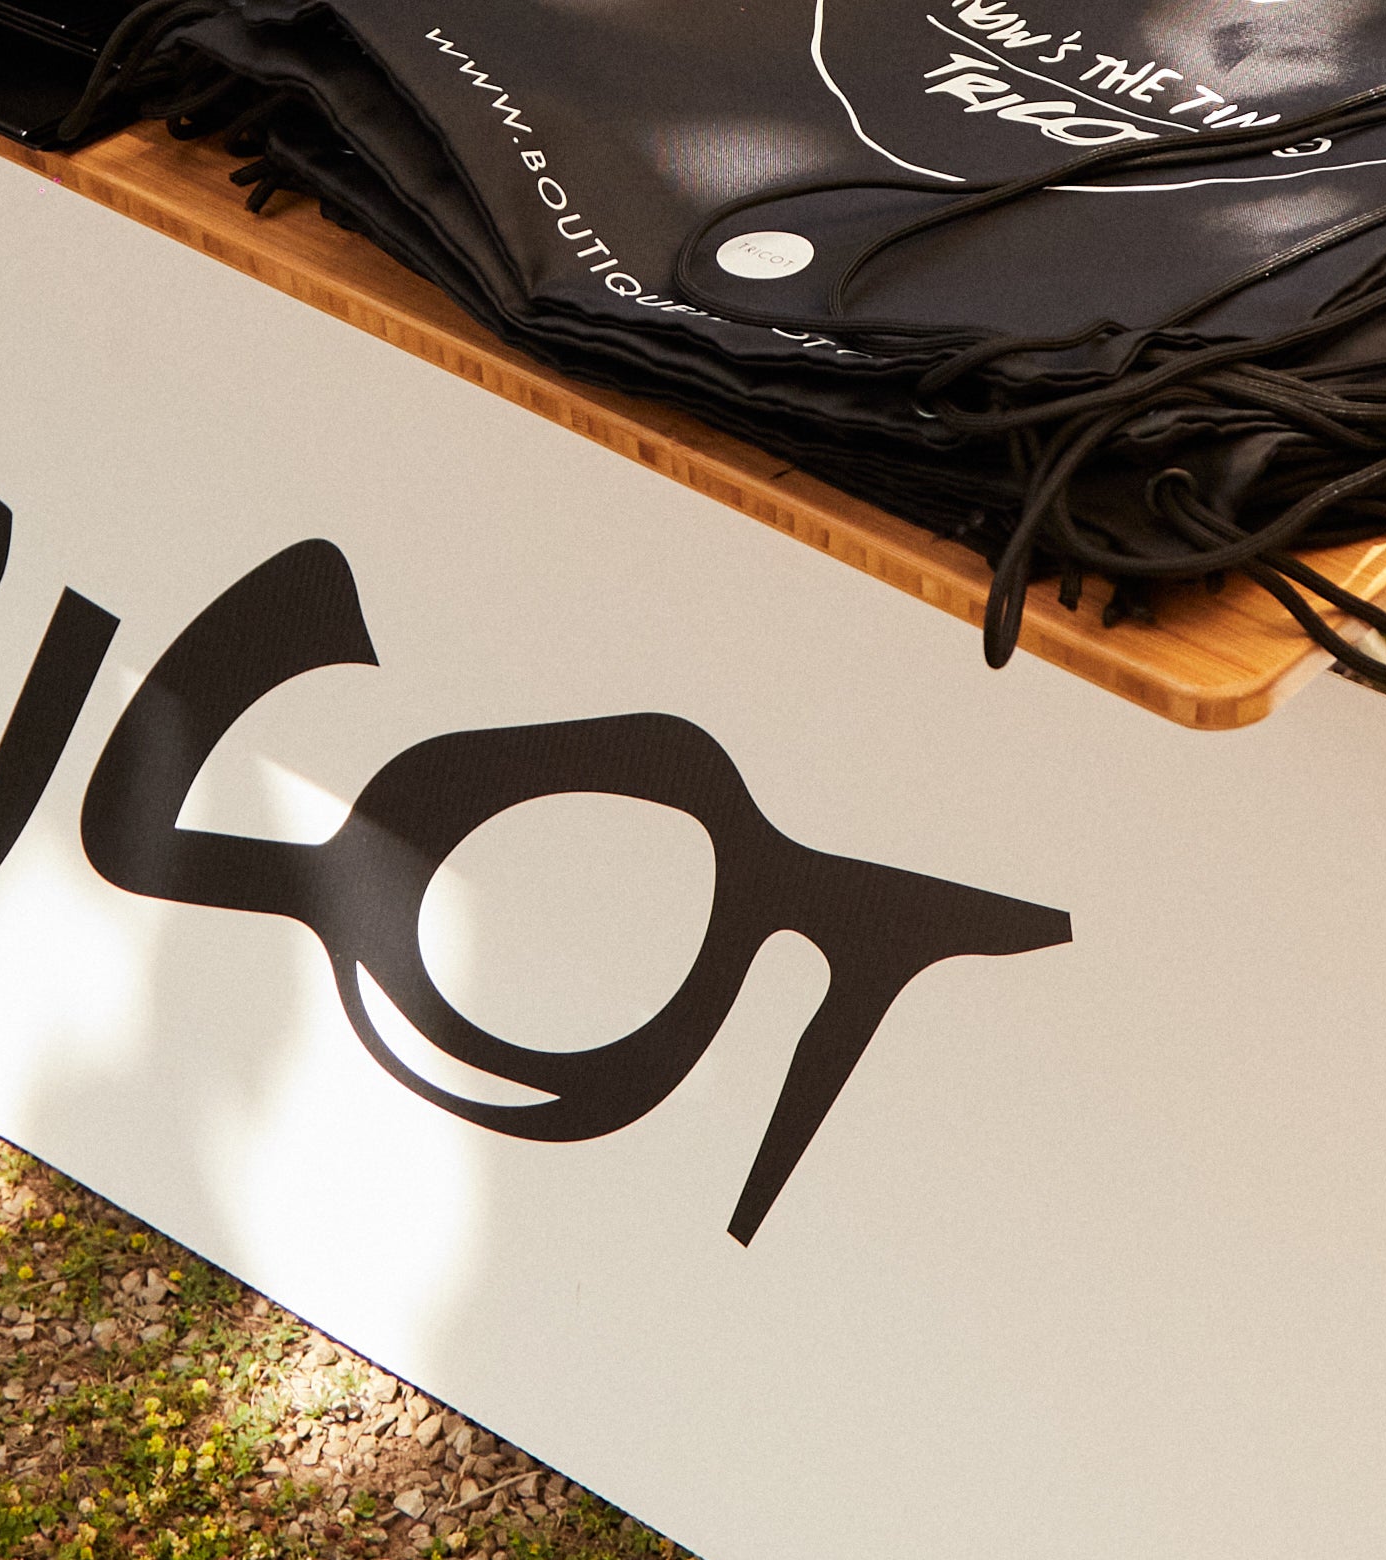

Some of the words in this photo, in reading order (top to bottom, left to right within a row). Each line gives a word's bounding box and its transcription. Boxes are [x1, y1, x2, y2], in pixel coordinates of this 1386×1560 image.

[923, 53, 1160, 146] TRICO
[1079, 54, 1183, 103] THE
[737, 241, 795, 268] TRICOT
